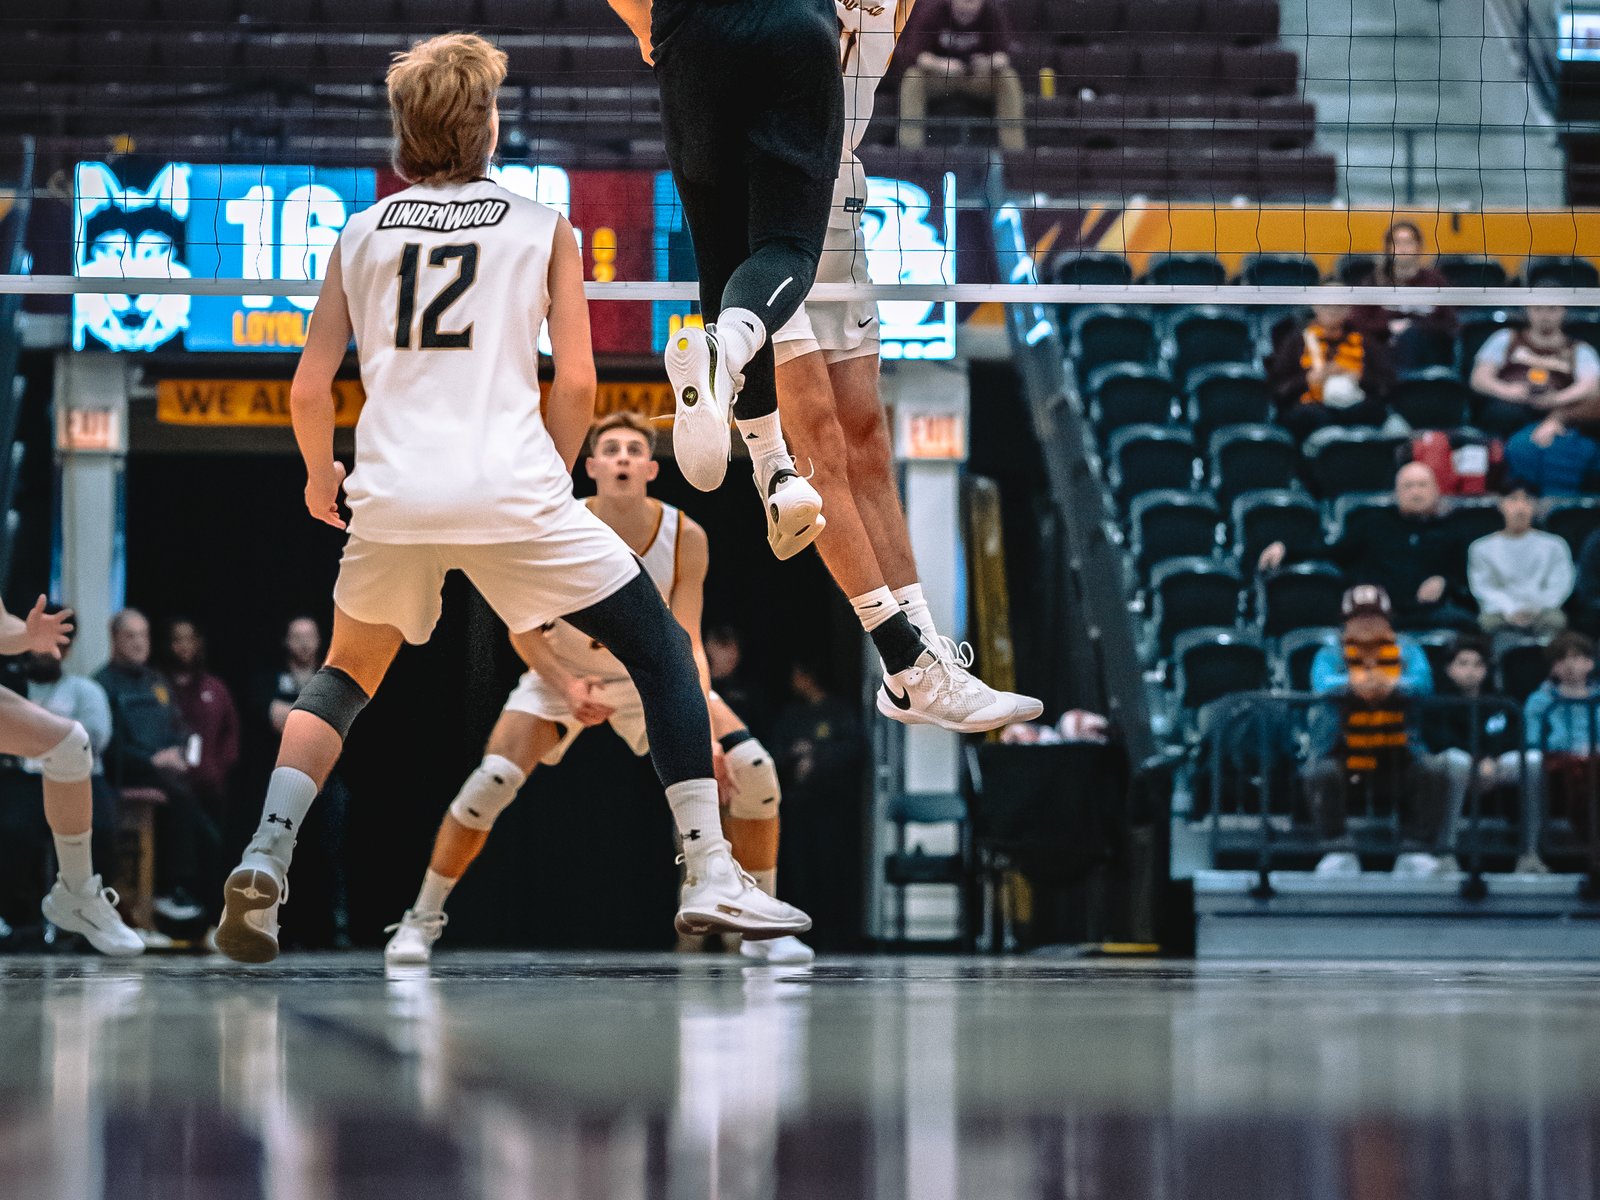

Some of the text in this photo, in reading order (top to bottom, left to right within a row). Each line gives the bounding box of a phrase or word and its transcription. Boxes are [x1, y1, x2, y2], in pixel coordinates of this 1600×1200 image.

[226, 185, 346, 310] 16
[381, 200, 508, 231] LINDENWOOD
[233, 311, 313, 346] LOYOL
[395, 241, 481, 351] 12
